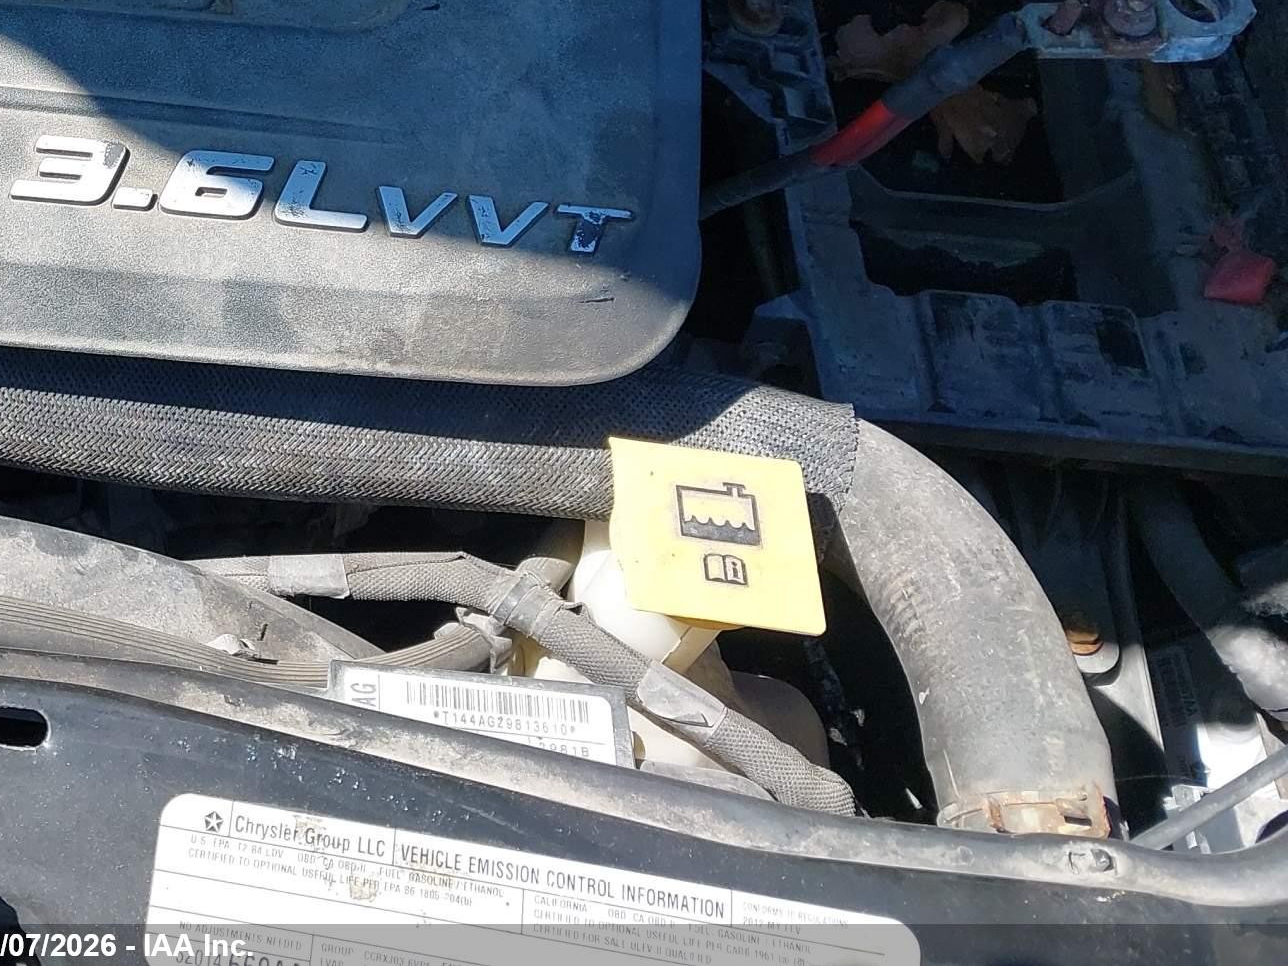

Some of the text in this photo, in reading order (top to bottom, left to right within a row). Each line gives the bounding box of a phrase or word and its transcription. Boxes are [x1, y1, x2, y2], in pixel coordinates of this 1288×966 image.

[376, 184, 635, 256] VVT
[188, 848, 235, 865] CERTIFIED
[239, 856, 250, 867] TO
[253, 859, 297, 876] OPTIONAL
[340, 875, 358, 886] LIFE
[384, 882, 401, 894] EPA
[235, 815, 724, 919] Chrysler Group LLC VEHICLE EMISSION CONTROL INFORMATION
[409, 872, 453, 890] GASOLINE
[464, 881, 504, 898] ETHANOL
[179, 921, 302, 951] NO ADJUSTMENTS NEEDED
[582, 932, 600, 944] FOR
[604, 937, 625, 948] SALE
[598, 922, 640, 937] OPTIONAL
